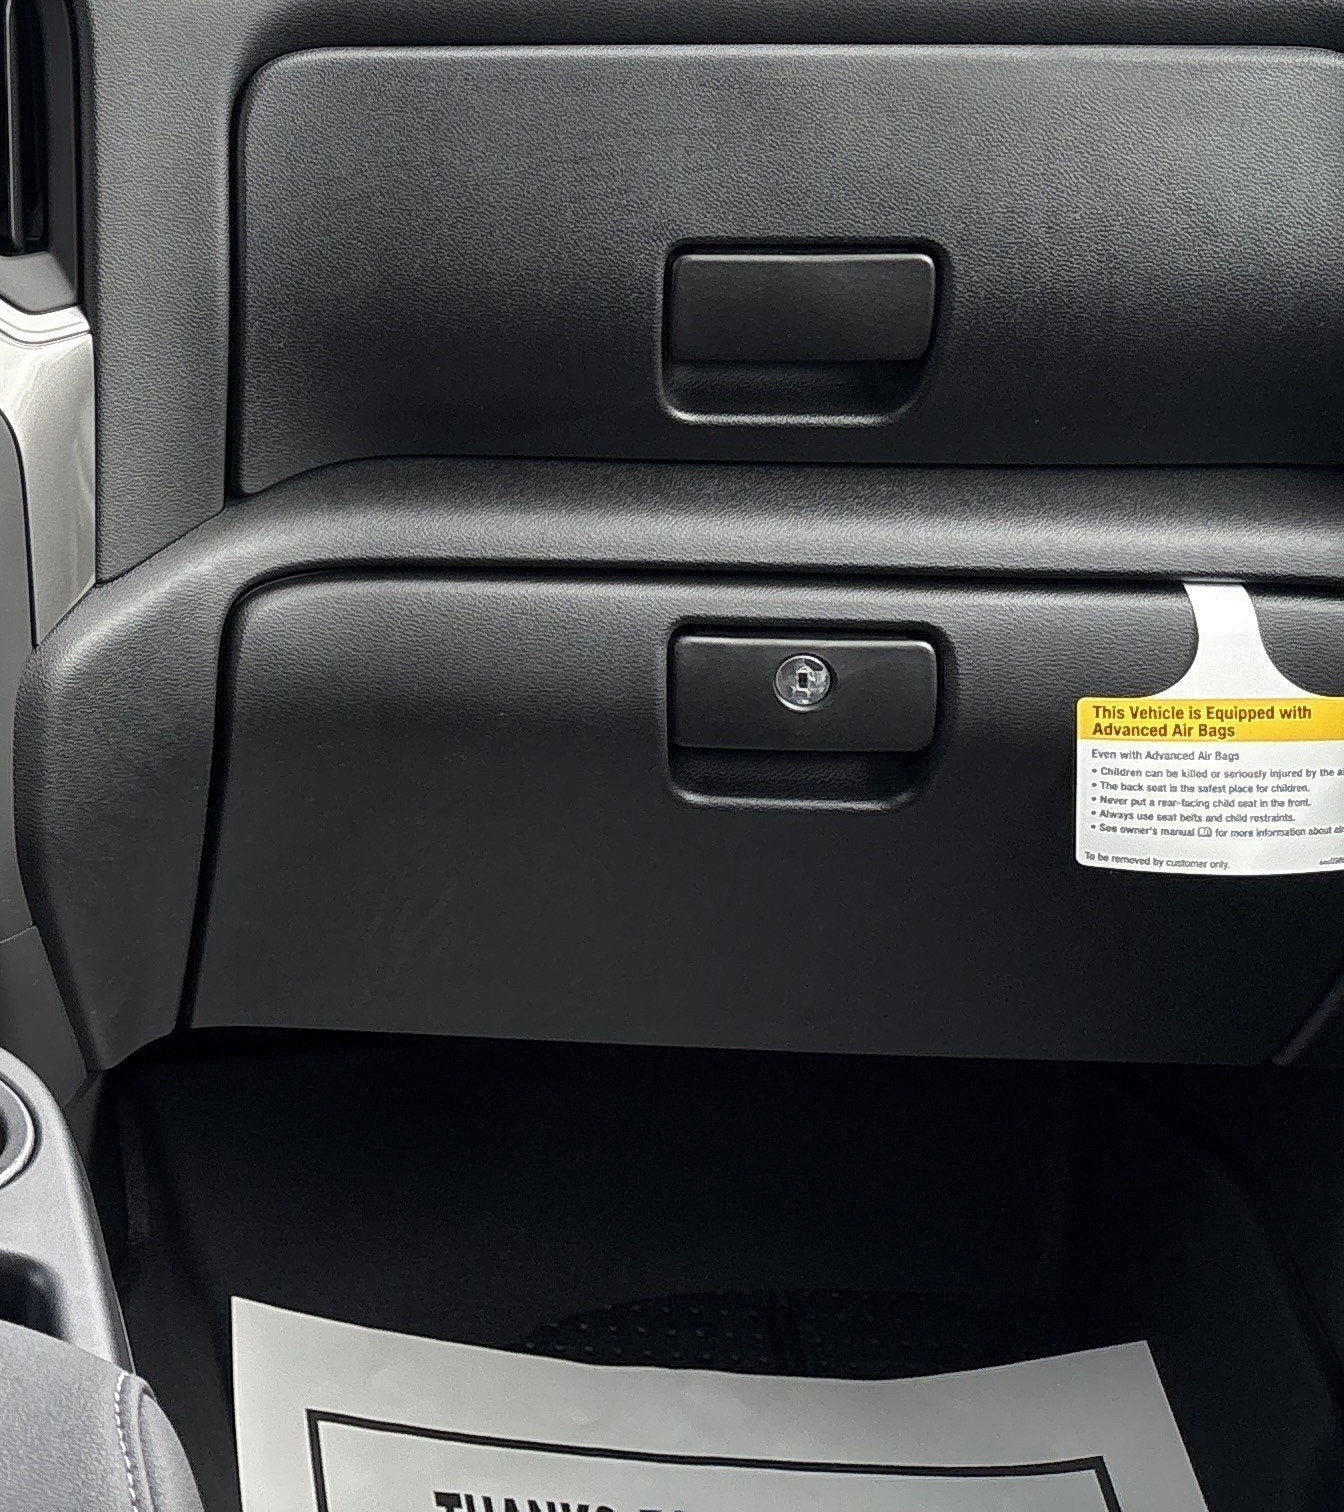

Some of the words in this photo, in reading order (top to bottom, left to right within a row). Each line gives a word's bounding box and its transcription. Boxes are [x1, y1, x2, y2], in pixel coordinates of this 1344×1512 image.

[1092, 705, 1125, 720] This
[1129, 705, 1185, 720] Vehicle
[1189, 706, 1202, 720] is
[1206, 705, 1275, 722] Equipped
[1278, 705, 1312, 720] with
[1092, 723, 1168, 737] Advanced
[1172, 723, 1194, 737] Air
[1198, 723, 1236, 740] Bags
[1091, 749, 1116, 760] Even
[1120, 749, 1143, 760] with
[1145, 750, 1195, 761] Advanced
[1198, 750, 1212, 761] Air
[1214, 750, 1240, 763] Bags
[1100, 766, 1143, 778] Children
[1145, 769, 1164, 778] can
[1166, 768, 1179, 778] be
[1181, 769, 1208, 779] killed
[1210, 771, 1221, 779] or
[1224, 769, 1267, 780] seriously
[1270, 769, 1303, 780] injured
[1305, 768, 1317, 779] by
[1320, 768, 1335, 777] the
[1100, 781, 1118, 791] The
[1120, 782, 1144, 792] back
[1146, 784, 1167, 793] seat
[1180, 784, 1195, 793] the
[1198, 784, 1226, 793] safest
[1228, 784, 1254, 795] place
[1256, 784, 1268, 793] for
[1271, 784, 1310, 793] children.
[1099, 795, 1128, 805] Never
[1130, 798, 1147, 807] put
[1157, 798, 1210, 809] rear-facing
[1213, 798, 1235, 808] child
[1237, 799, 1257, 808] seat
[1259, 798, 1268, 808] in
[1270, 798, 1285, 808] the
[1099, 809, 1134, 821] Always
[1136, 813, 1154, 821] use
[1156, 813, 1177, 822] seat
[1179, 813, 1203, 823] belts
[1205, 814, 1223, 823] and
[1225, 813, 1248, 823] child
[1250, 813, 1296, 822] restraints.
[1099, 823, 1118, 833] See
[1120, 826, 1158, 836] owner's
[1160, 827, 1195, 837] manual
[1215, 828, 1228, 837] for
[1230, 829, 1254, 837] more
[1256, 827, 1306, 837] information
[1308, 826, 1332, 836] about
[1084, 851, 1096, 861] To
[1097, 852, 1109, 862] be
[1111, 855, 1151, 866] removed
[1152, 857, 1164, 868] by
[1166, 859, 1207, 869] customer
